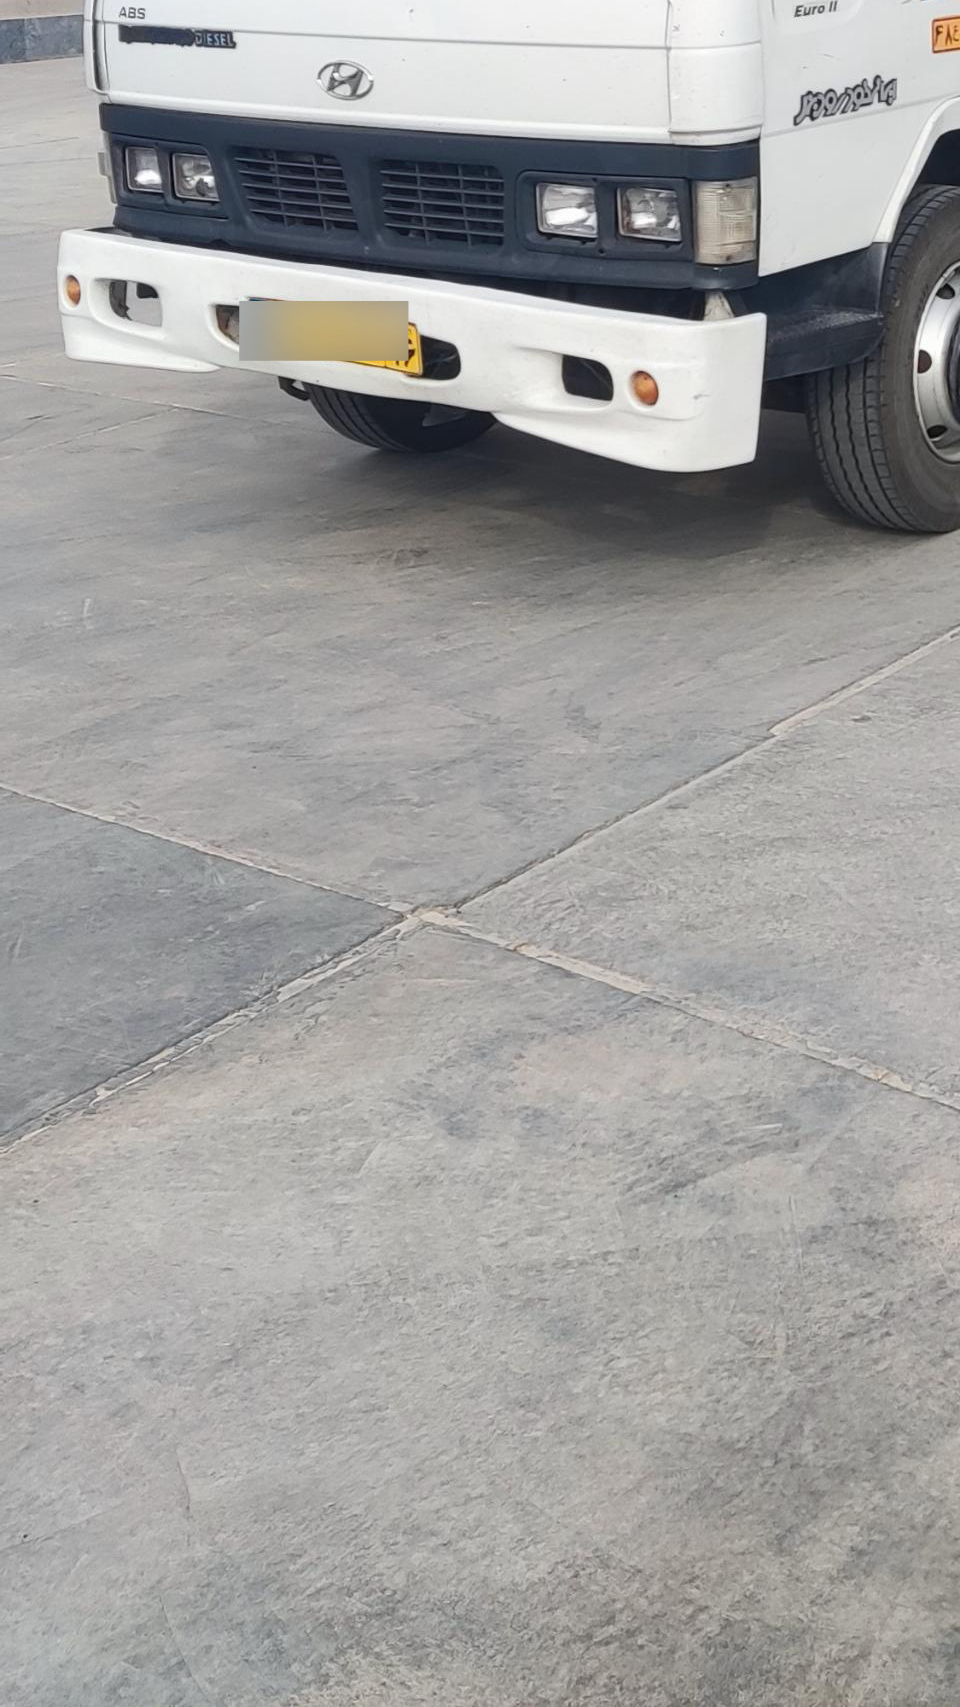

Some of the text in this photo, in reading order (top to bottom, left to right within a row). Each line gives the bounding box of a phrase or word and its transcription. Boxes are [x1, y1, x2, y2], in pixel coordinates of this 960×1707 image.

[119, 6, 146, 20] ABS
[794, 5, 826, 18] Euro
[195, 32, 234, 47] DIESEL
